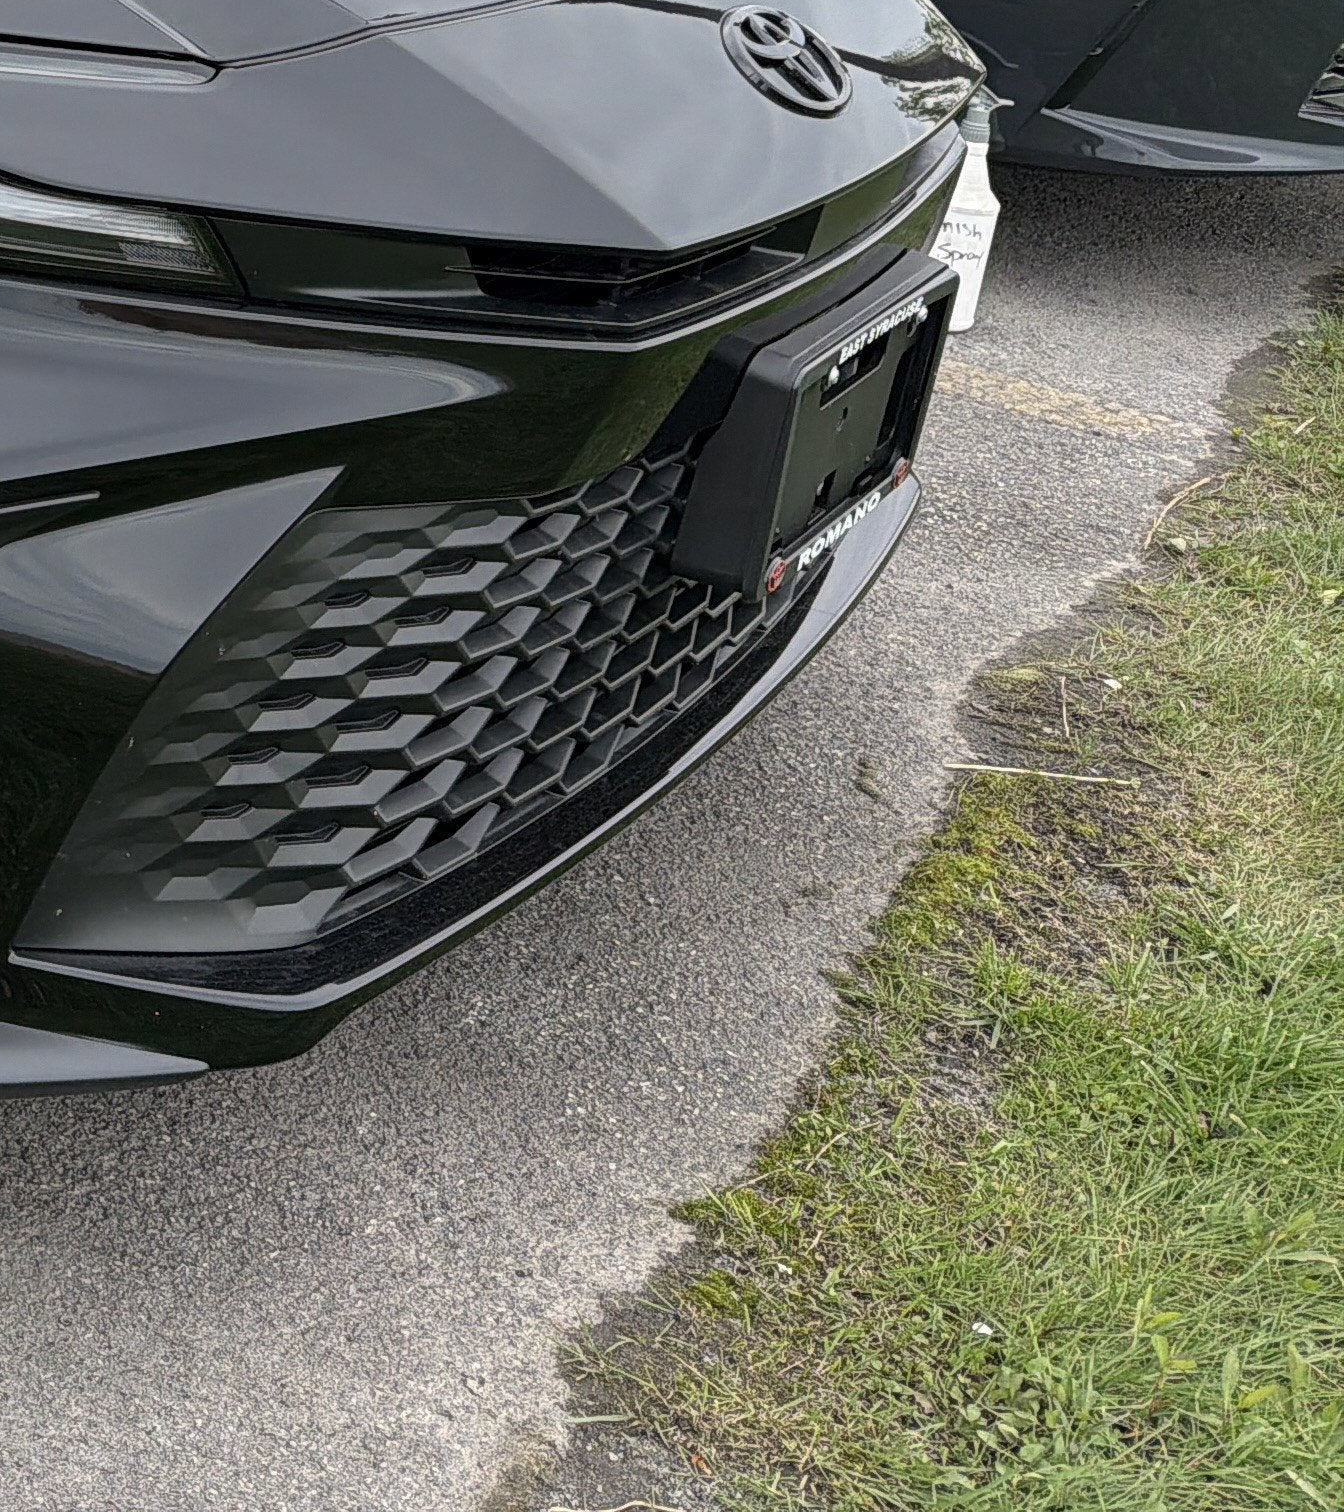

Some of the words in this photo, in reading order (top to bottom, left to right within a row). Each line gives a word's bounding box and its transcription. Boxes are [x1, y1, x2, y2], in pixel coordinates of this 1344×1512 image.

[937, 242, 984, 269] Spray
[839, 332, 869, 365] EAST
[867, 295, 924, 344] SYRACUSE
[797, 491, 881, 571] ROMANO
